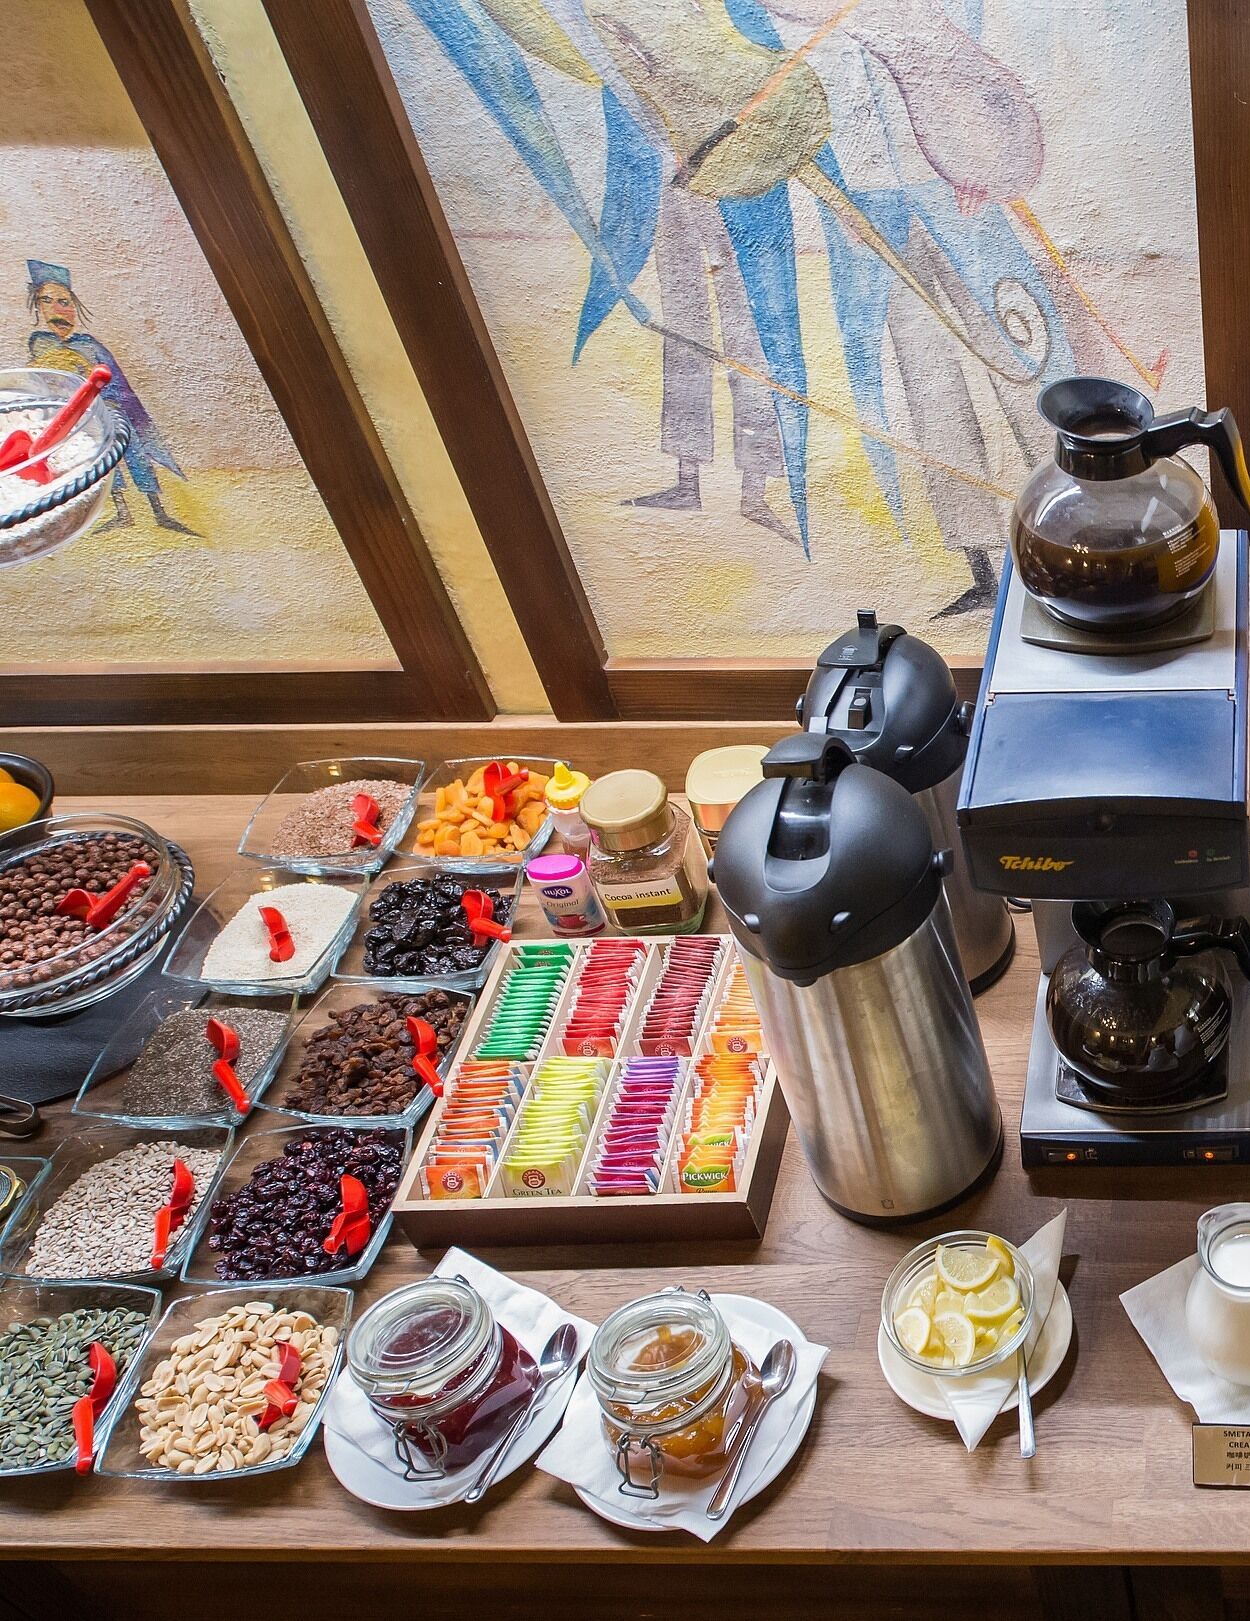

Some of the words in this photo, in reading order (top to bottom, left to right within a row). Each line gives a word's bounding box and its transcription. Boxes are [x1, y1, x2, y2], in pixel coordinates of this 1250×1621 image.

[1000, 856, 1074, 871] Tchibo
[604, 893, 633, 902] Cocoa
[636, 888, 671, 899] instant
[547, 899, 579, 908] Original
[683, 1172, 728, 1181] PICKWICK
[512, 1188, 542, 1196] GREEN
[545, 1187, 562, 1195] TEA
